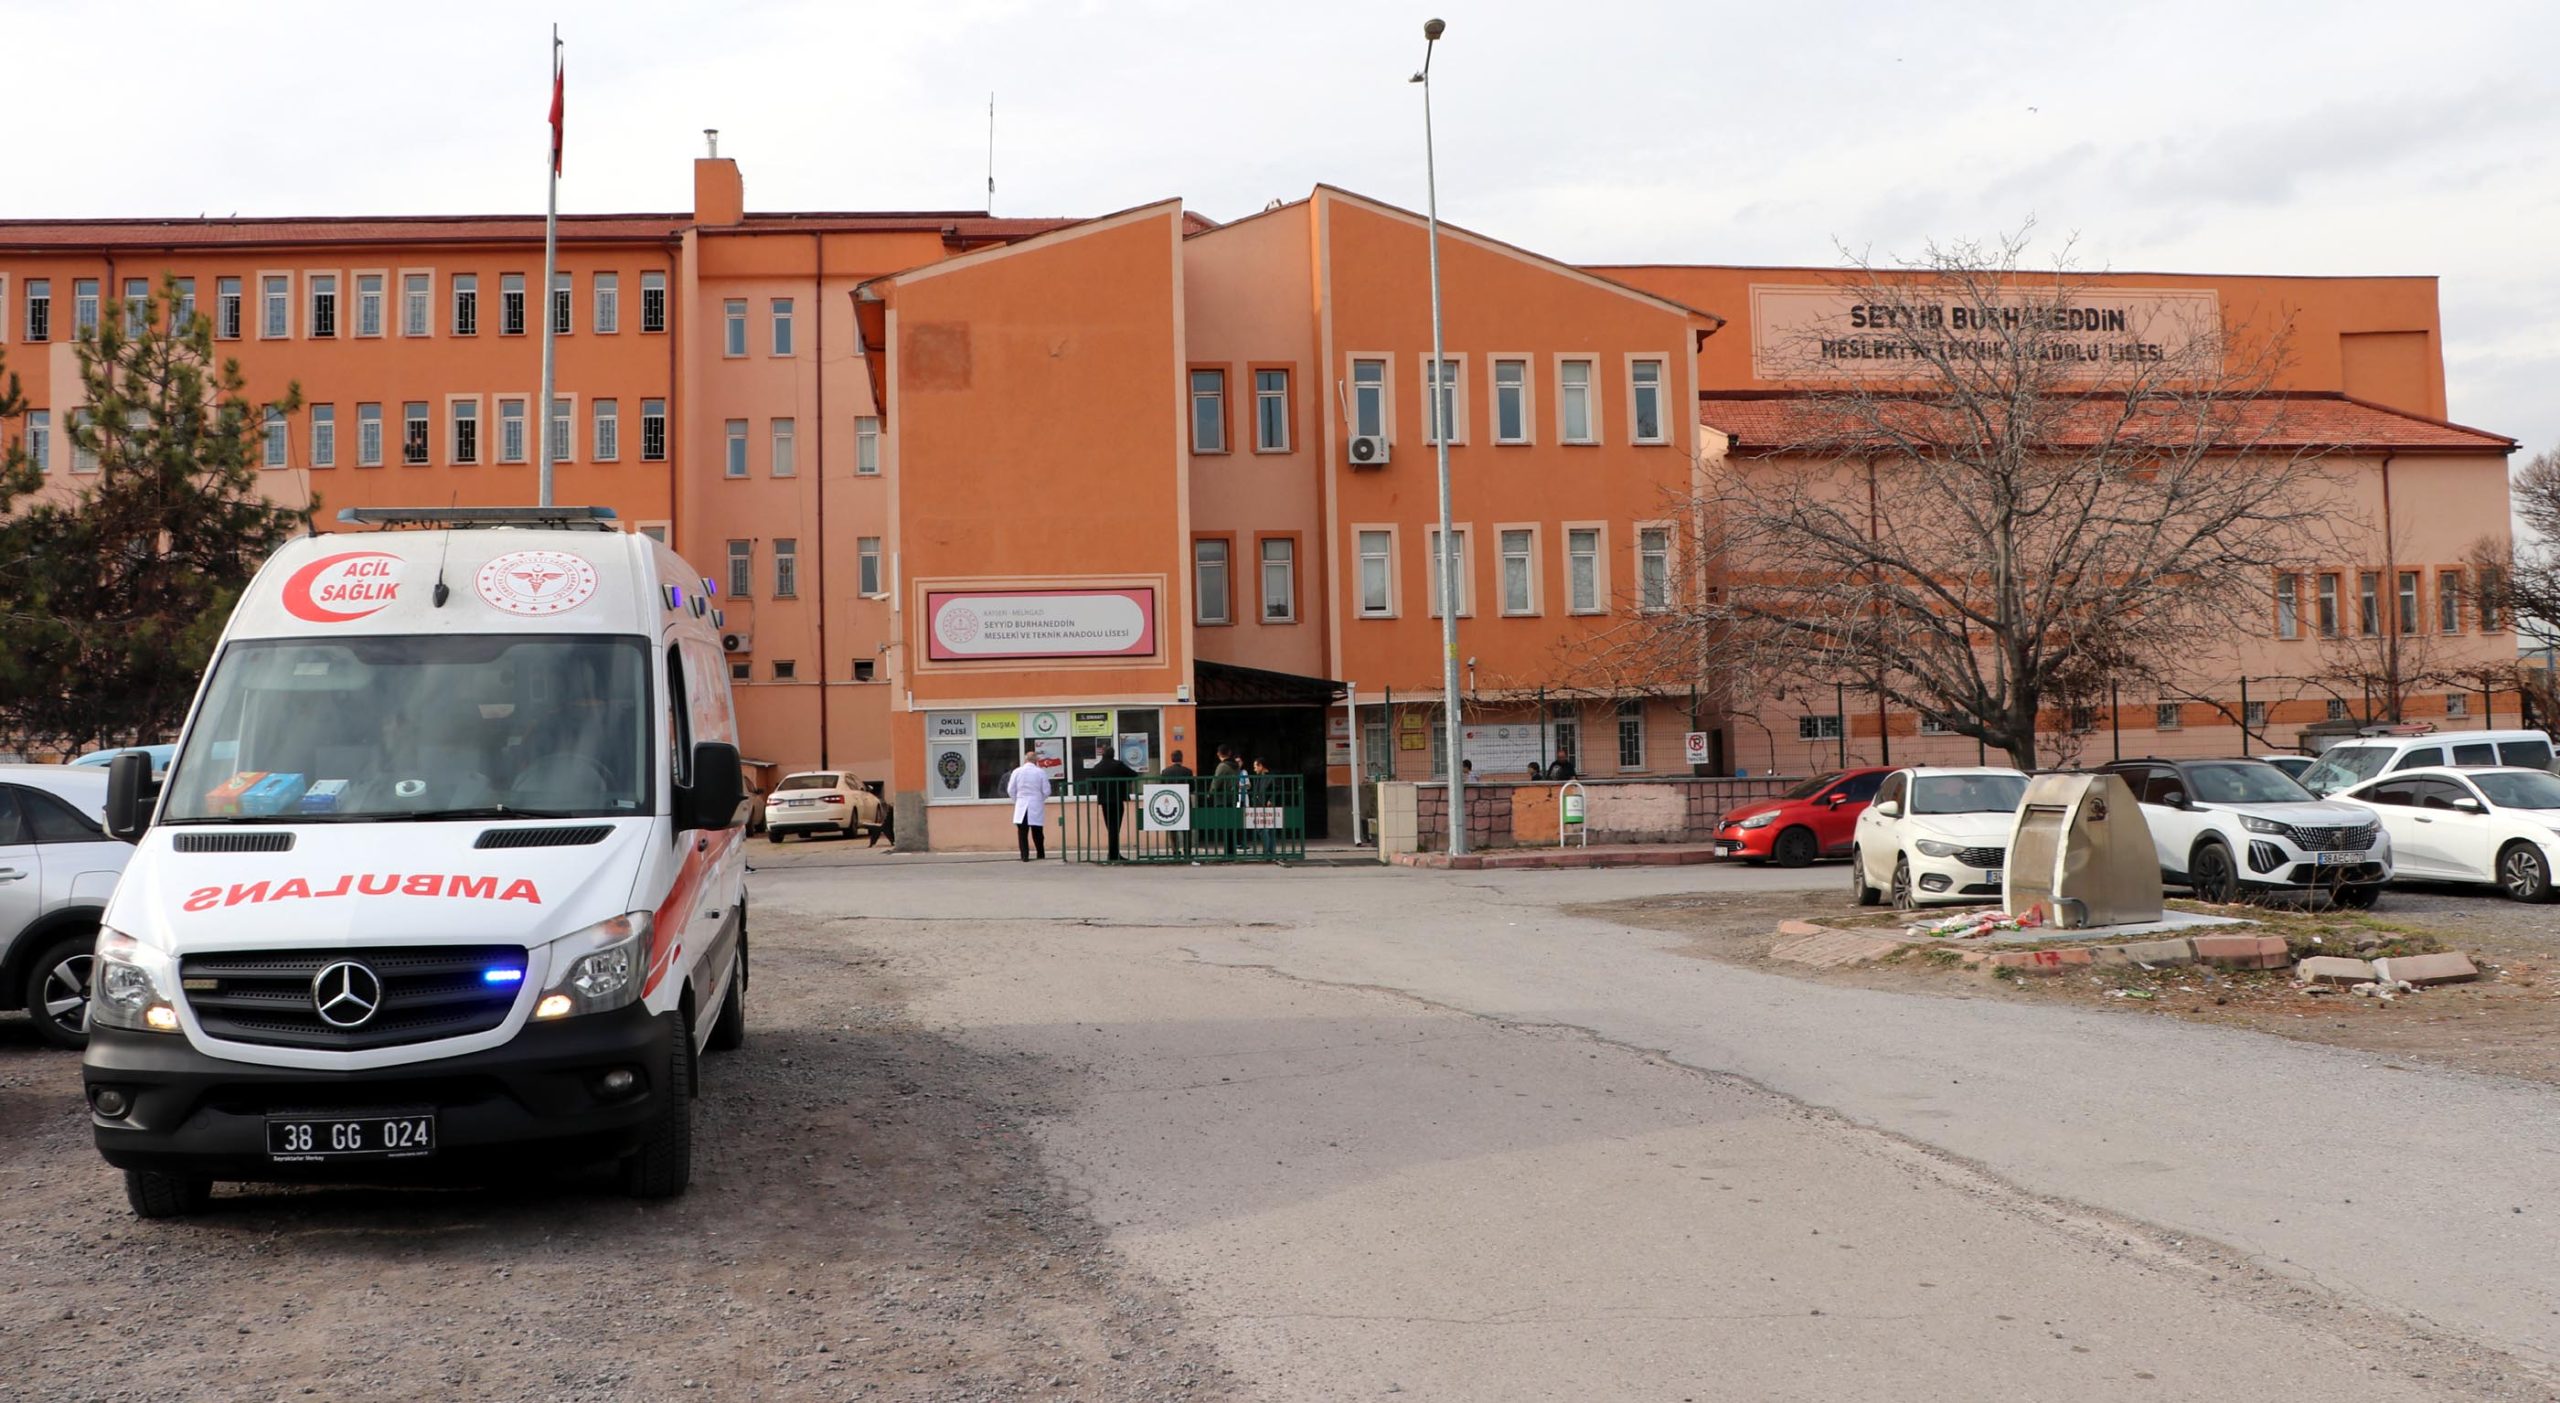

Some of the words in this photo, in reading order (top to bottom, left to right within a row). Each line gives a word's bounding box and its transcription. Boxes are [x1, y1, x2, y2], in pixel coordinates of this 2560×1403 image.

[2011, 342, 2099, 362] NADOLU
[342, 559, 390, 577] ACİL
[319, 579, 400, 602] SAĞLIK
[984, 621, 1014, 629] SEYYİD
[1015, 620, 1075, 628] BURHANEDDİN
[984, 631, 1020, 640] MESLEKİ
[1021, 631, 1031, 639] VE
[1033, 631, 1061, 639] TEKNİK
[1063, 630, 1102, 638] ANADOLU
[1105, 629, 1129, 637] LİSESİ
[939, 728, 966, 736] POLİSİ
[980, 721, 1017, 730] DANIŞMA
[285, 1125, 312, 1150] 38
[332, 1124, 361, 1149] GG
[384, 1121, 428, 1147] 024
